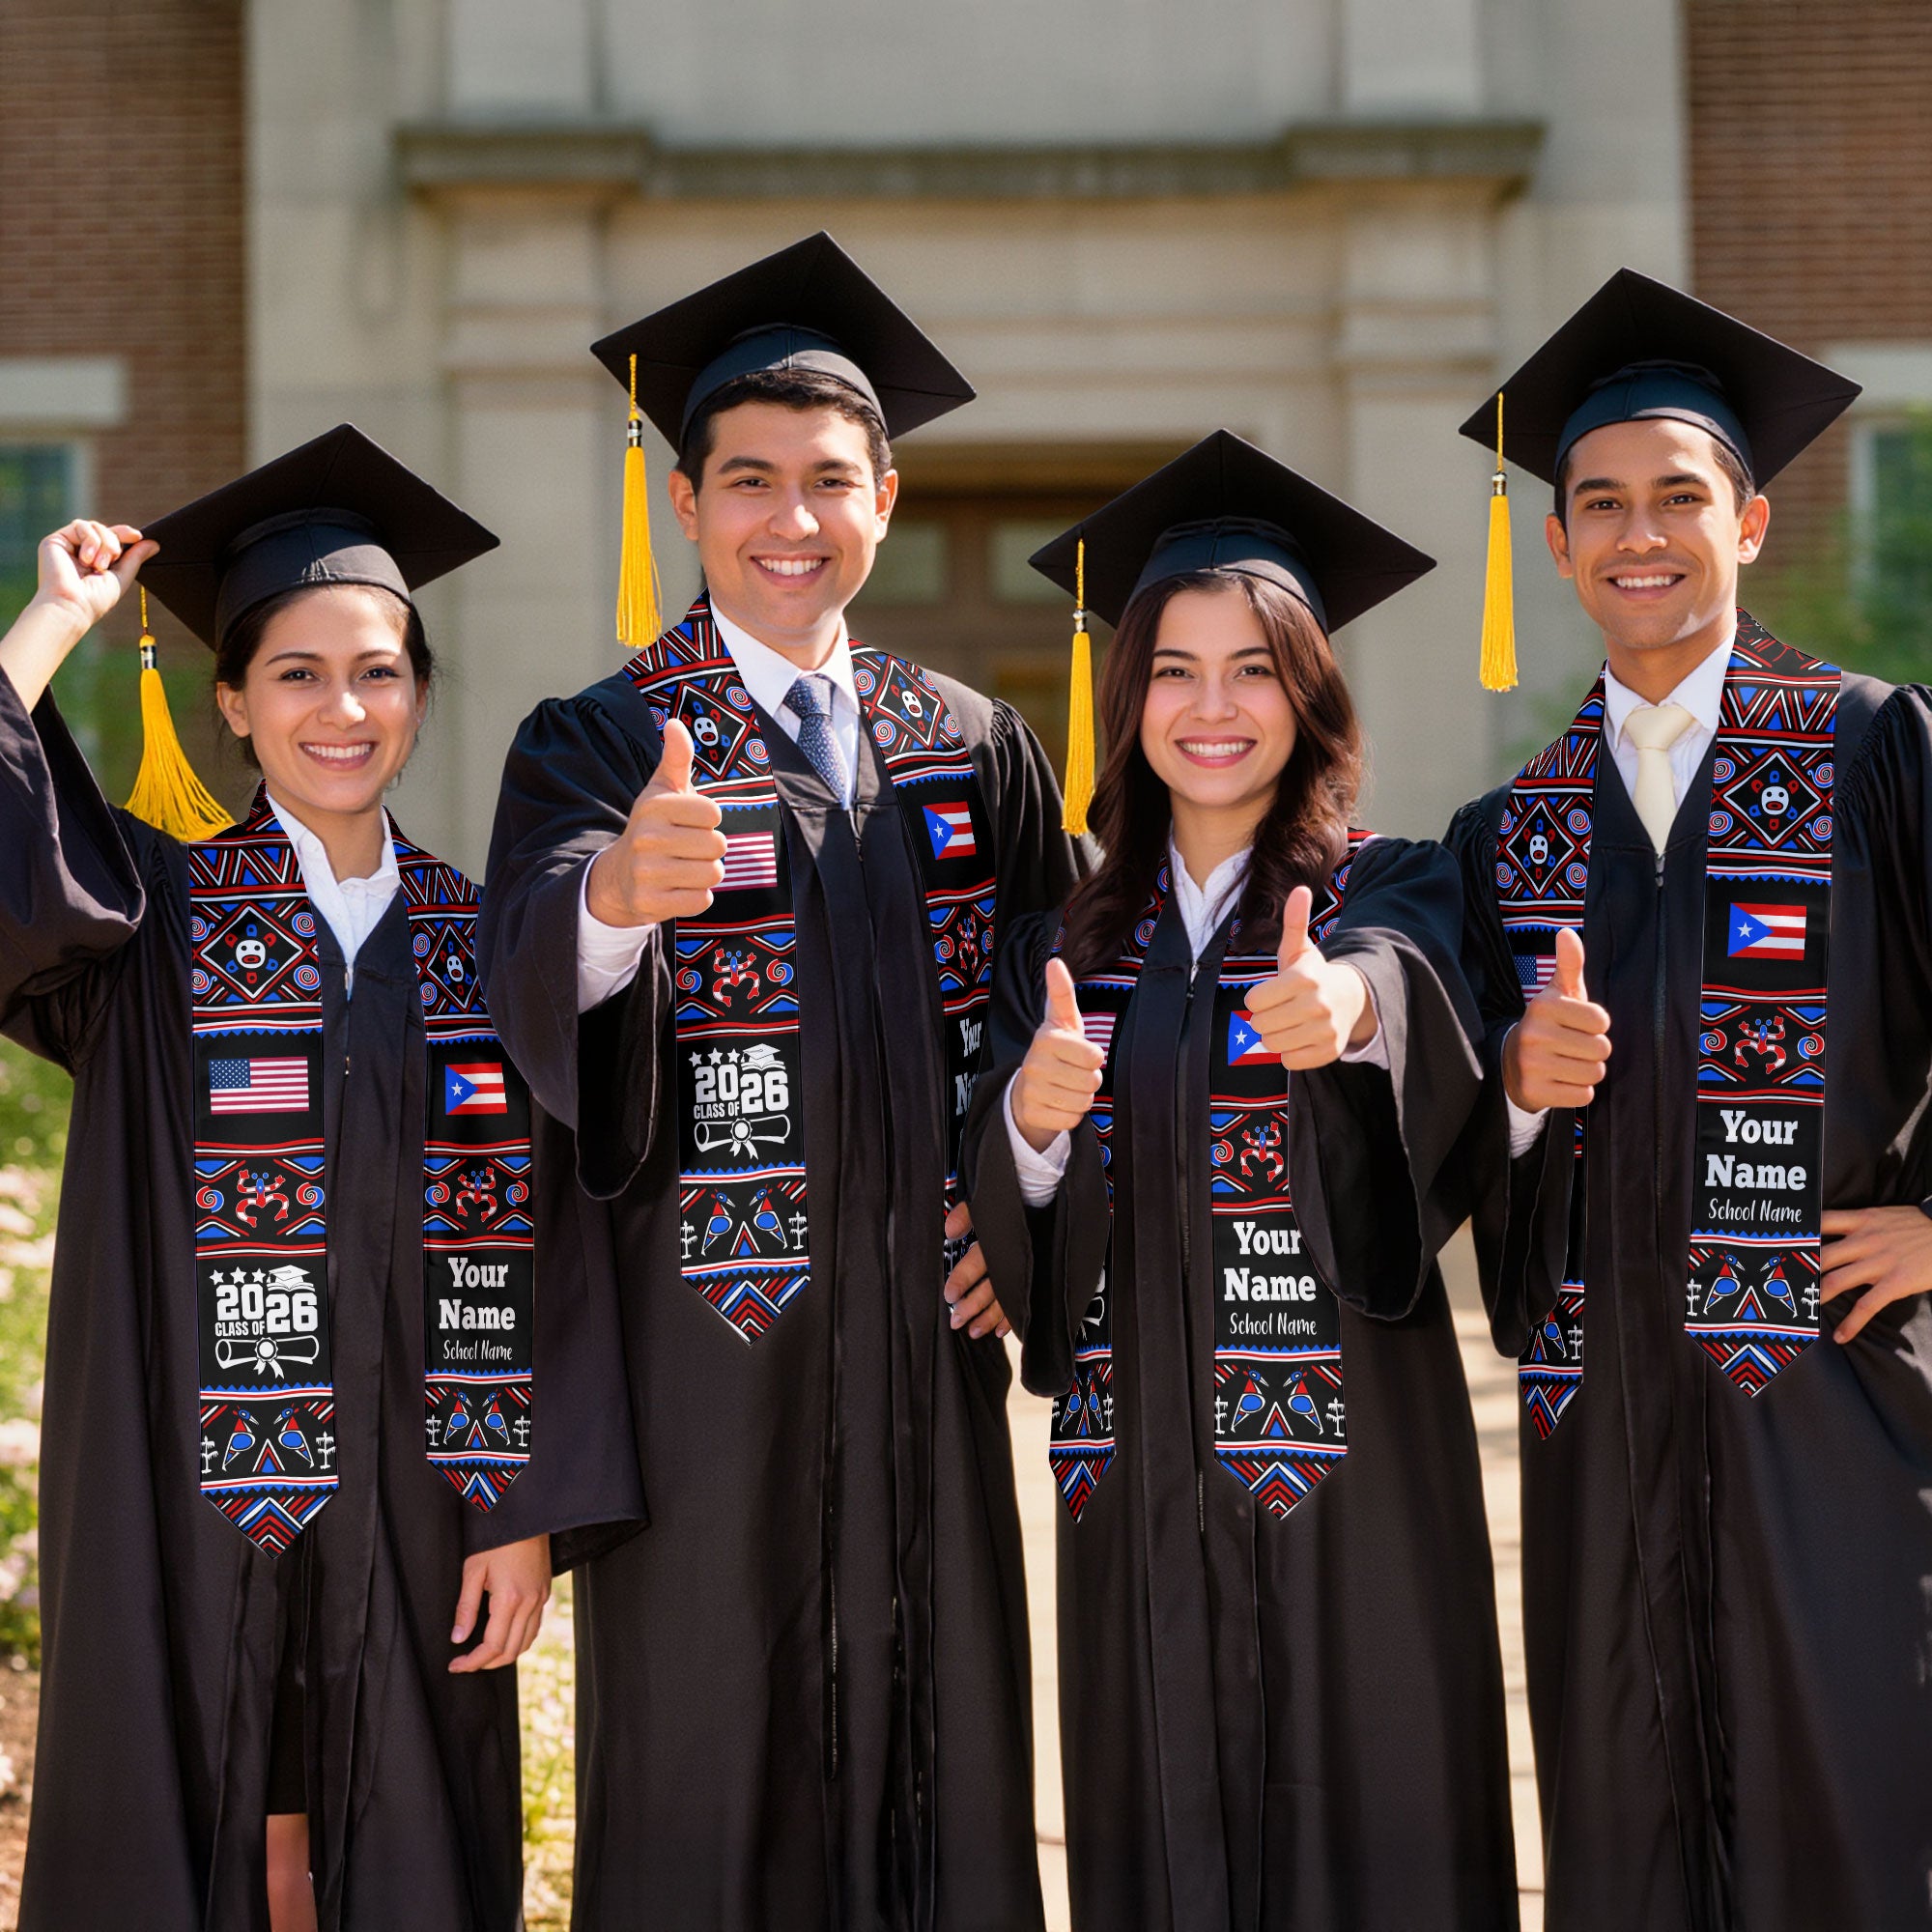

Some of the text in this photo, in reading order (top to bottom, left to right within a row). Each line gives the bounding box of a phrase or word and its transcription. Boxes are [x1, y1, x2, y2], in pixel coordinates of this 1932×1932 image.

[959, 1017, 983, 1059] Your
[695, 1064, 790, 1115] 2026
[954, 1071, 980, 1117] Na
[693, 1100, 740, 1120] CLASS OF
[1719, 1109, 1799, 1146] Your
[1704, 1153, 1807, 1191] Name
[1708, 1197, 1803, 1223] School Name
[1233, 1221, 1302, 1256] Your
[447, 1256, 510, 1289] Your
[1223, 1266, 1317, 1302] Name
[214, 1283, 319, 1334] 2026
[438, 1298, 517, 1331] Name
[1229, 1311, 1318, 1336] School Name
[213, 1320, 266, 1337] CLASS OF
[442, 1339, 513, 1361] School Name
